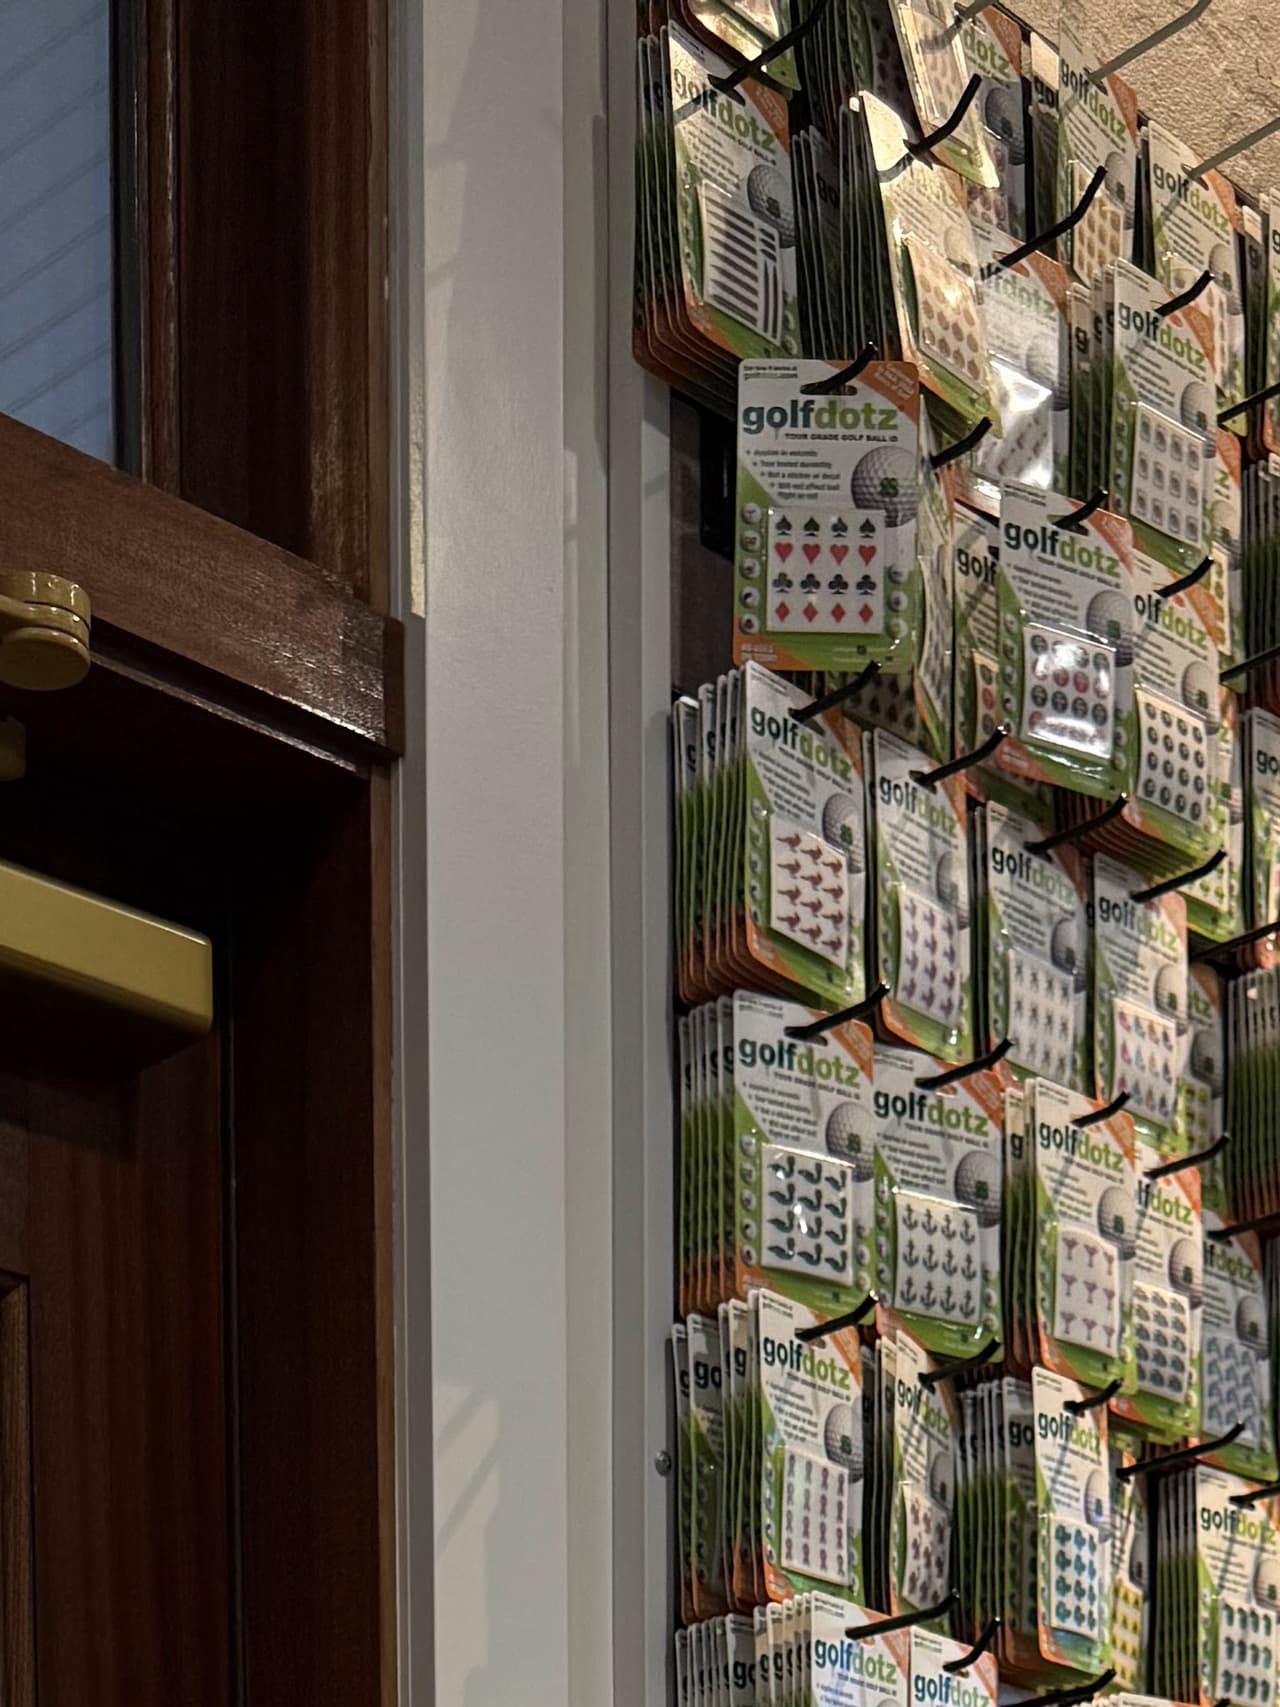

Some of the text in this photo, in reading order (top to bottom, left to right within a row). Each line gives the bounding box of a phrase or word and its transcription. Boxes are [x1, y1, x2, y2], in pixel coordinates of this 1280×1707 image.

[674, 69, 777, 155] golfdotz
[1060, 56, 1126, 142] golfdotz
[1153, 162, 1231, 231] golfdotz
[1117, 297, 1205, 381] golfdotz
[742, 400, 898, 434] golfdotz
[841, 433, 864, 442] GOLF
[866, 434, 887, 442] BALL
[1004, 521, 1121, 577] golfdotz
[751, 706, 853, 782] golfdotz
[880, 776, 957, 836] golfdotz
[992, 847, 1083, 896] golfdotz
[1098, 895, 1179, 949] golfdotz
[739, 1037, 860, 1088] golfdotz
[874, 1090, 988, 1136] golfdotz
[1039, 1121, 1123, 1172] golfdotz
[763, 1335, 850, 1389] golfdotz
[898, 1378, 950, 1434] golfdotz
[1038, 1411, 1101, 1456] golfdotz
[1201, 1505, 1275, 1545] golfdotz
[815, 1638, 897, 1684] golfdotz
